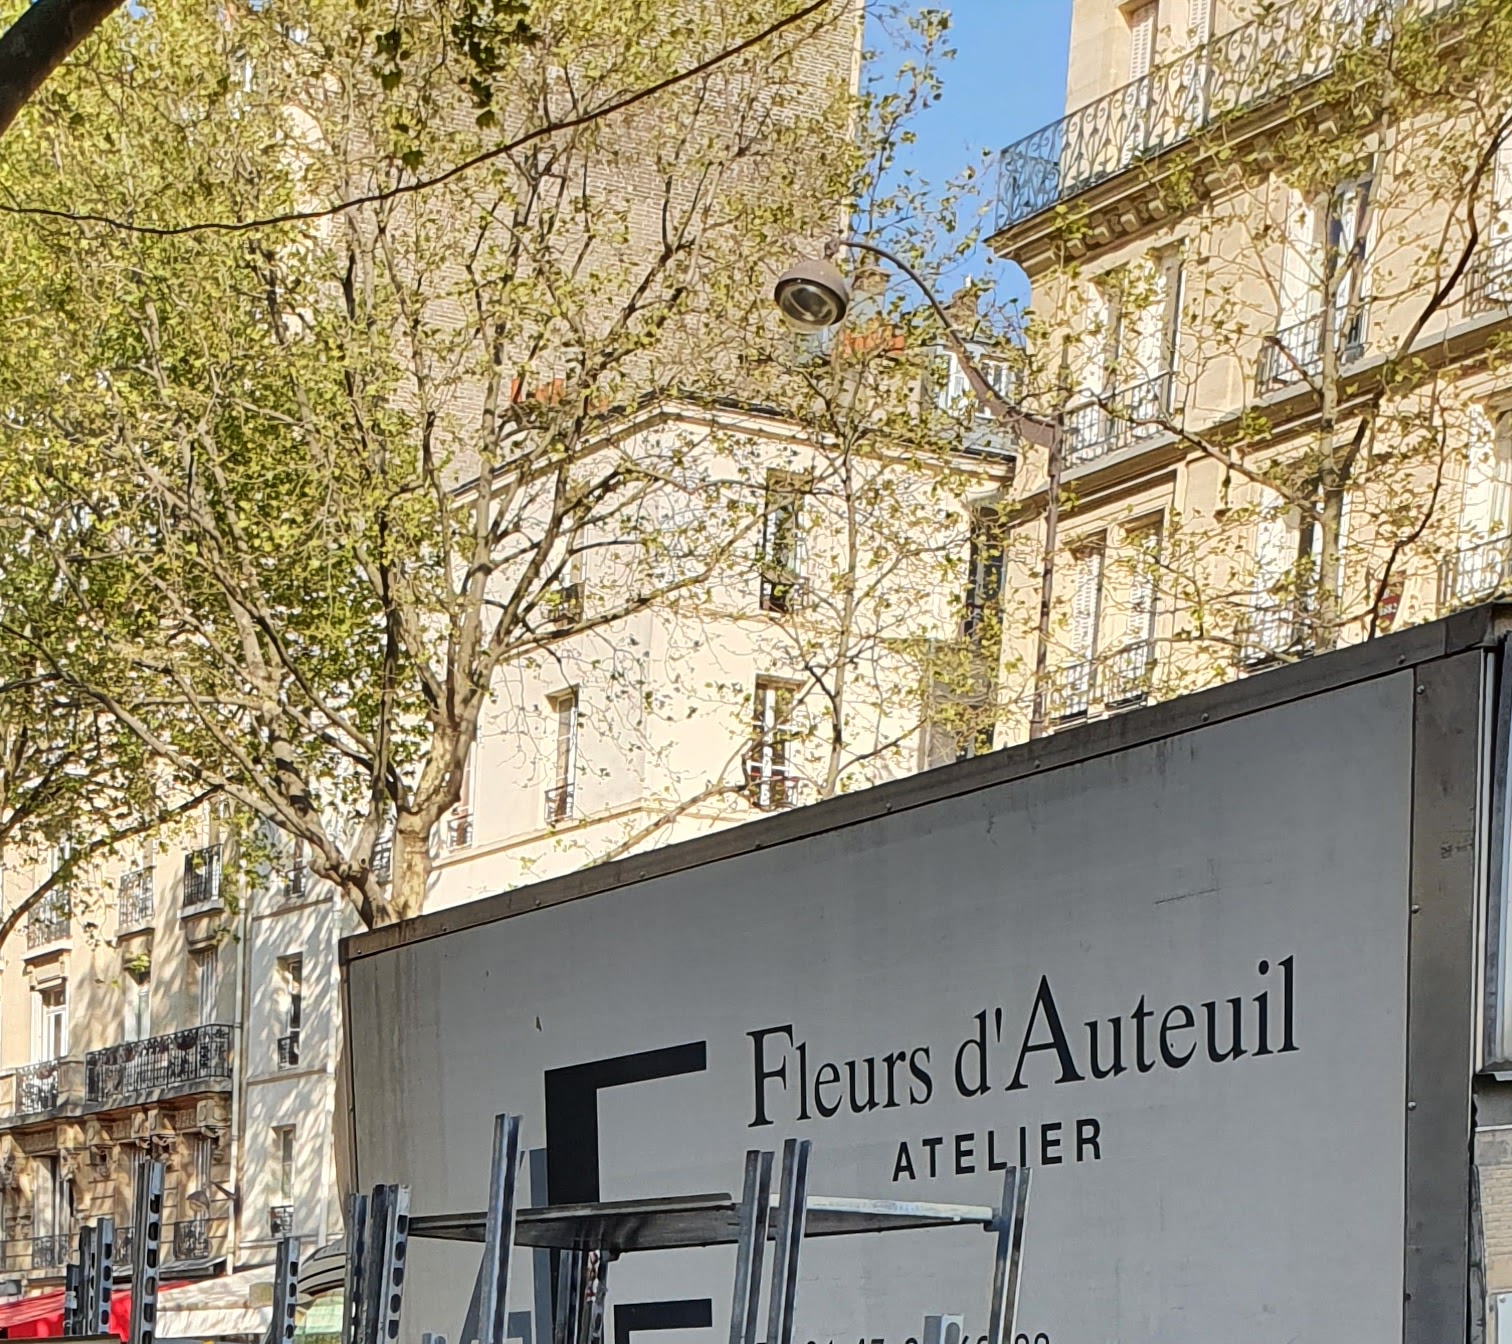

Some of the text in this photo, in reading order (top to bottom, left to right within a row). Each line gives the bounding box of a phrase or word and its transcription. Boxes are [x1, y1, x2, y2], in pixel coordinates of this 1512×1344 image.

[745, 954, 1301, 1128] Fleurs d'Auteuil
[891, 1117, 1103, 1183] ATELIER
